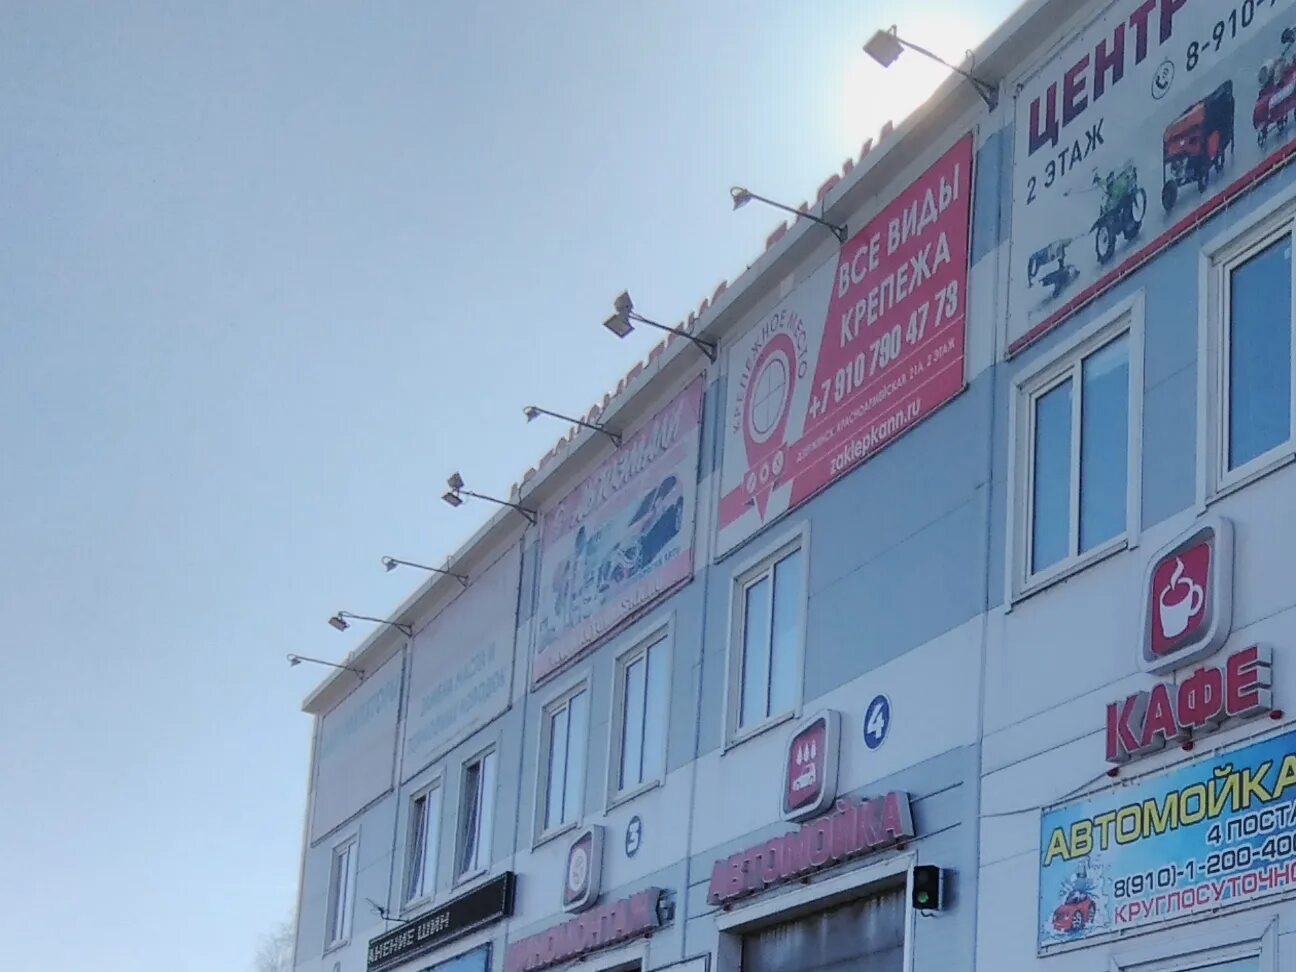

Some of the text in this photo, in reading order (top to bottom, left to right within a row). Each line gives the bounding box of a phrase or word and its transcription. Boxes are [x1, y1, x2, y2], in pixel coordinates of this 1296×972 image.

[1028, 0, 1187, 157] ЦЕНТР
[1186, 0, 1275, 71] 8-910-
[1027, 118, 1104, 205] 2 ЭТАЖ
[838, 163, 960, 299] ВСЕ ВИДЫ
[840, 231, 950, 348] КРЕПЕЖА
[809, 378, 831, 418] +7
[869, 323, 901, 376] 790
[906, 302, 929, 345] 47
[829, 398, 921, 475] zaklepkann.ru
[866, 702, 886, 739] 4
[1106, 646, 1260, 763] КАФЕ
[1207, 824, 1221, 845] 4
